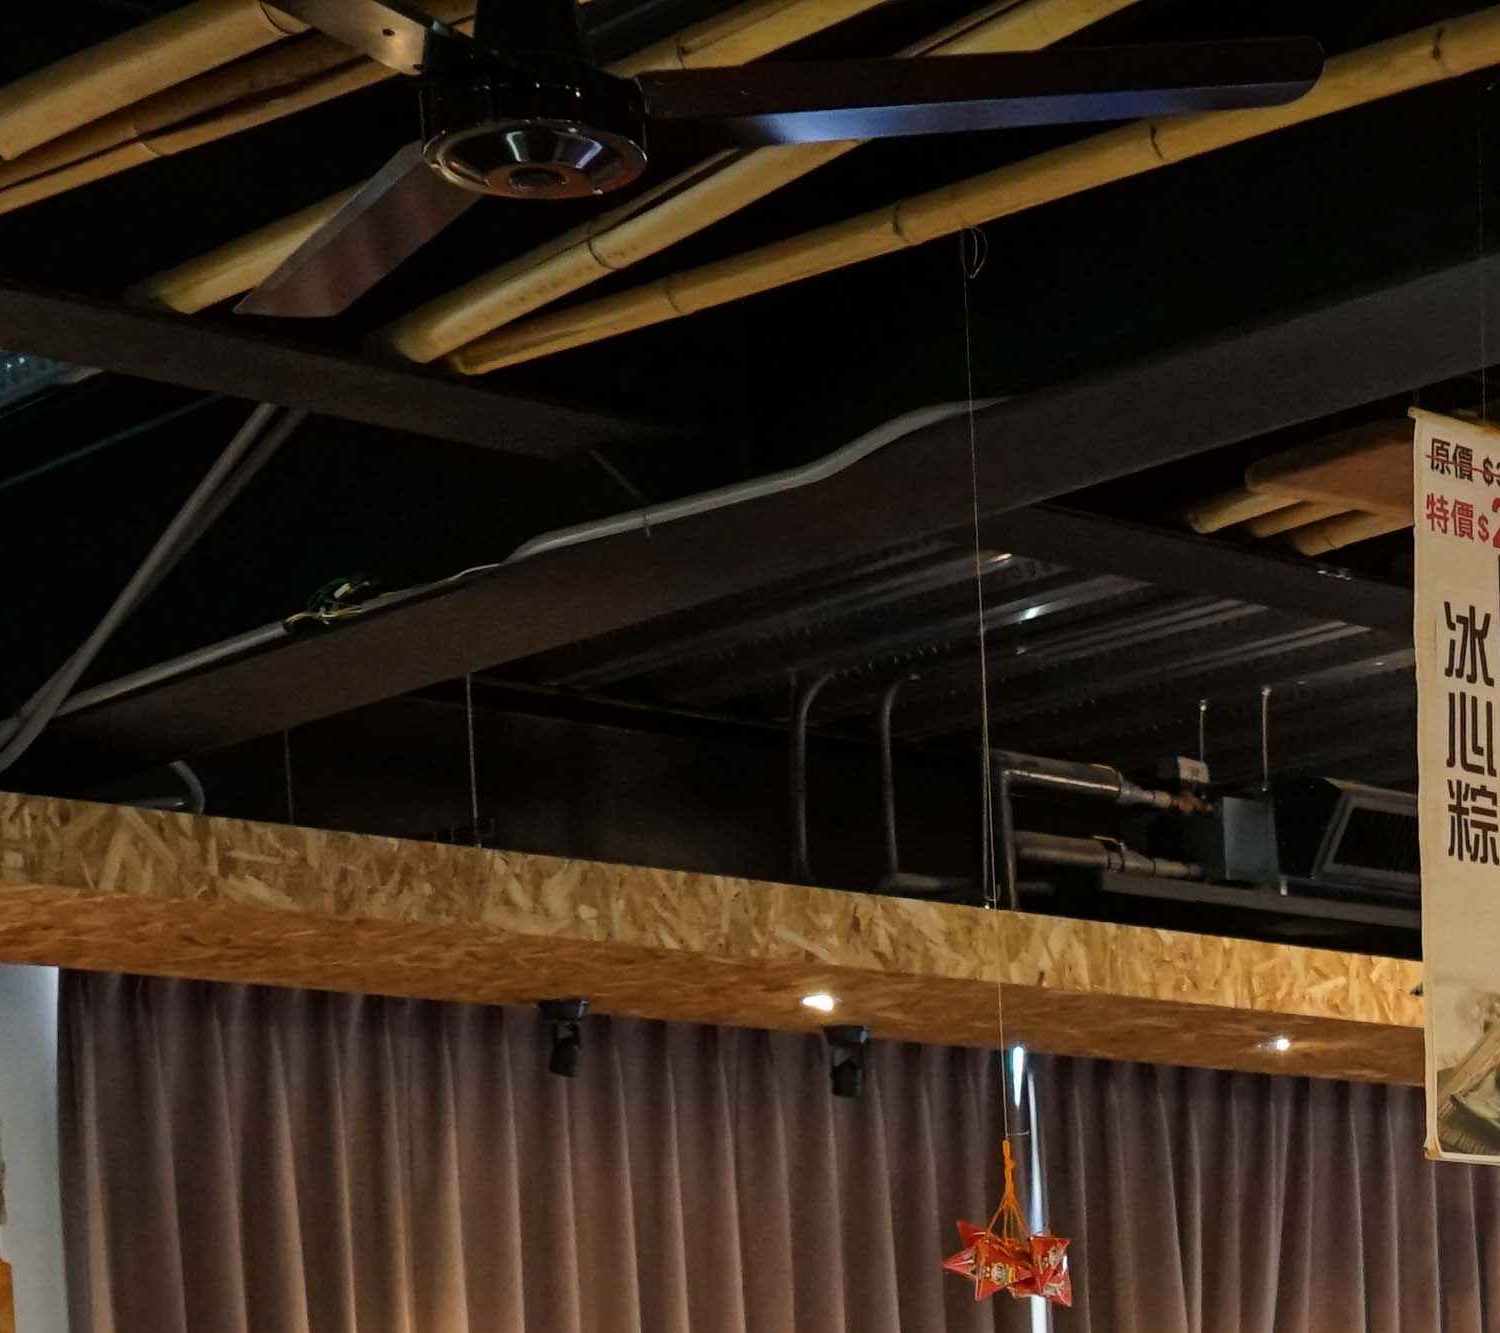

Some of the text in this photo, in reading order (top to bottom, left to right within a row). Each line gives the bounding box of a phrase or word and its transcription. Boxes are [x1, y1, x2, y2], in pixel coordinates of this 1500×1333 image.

[1431, 438, 1474, 482] 原價
[1443, 600, 1500, 867] 冰心粽
